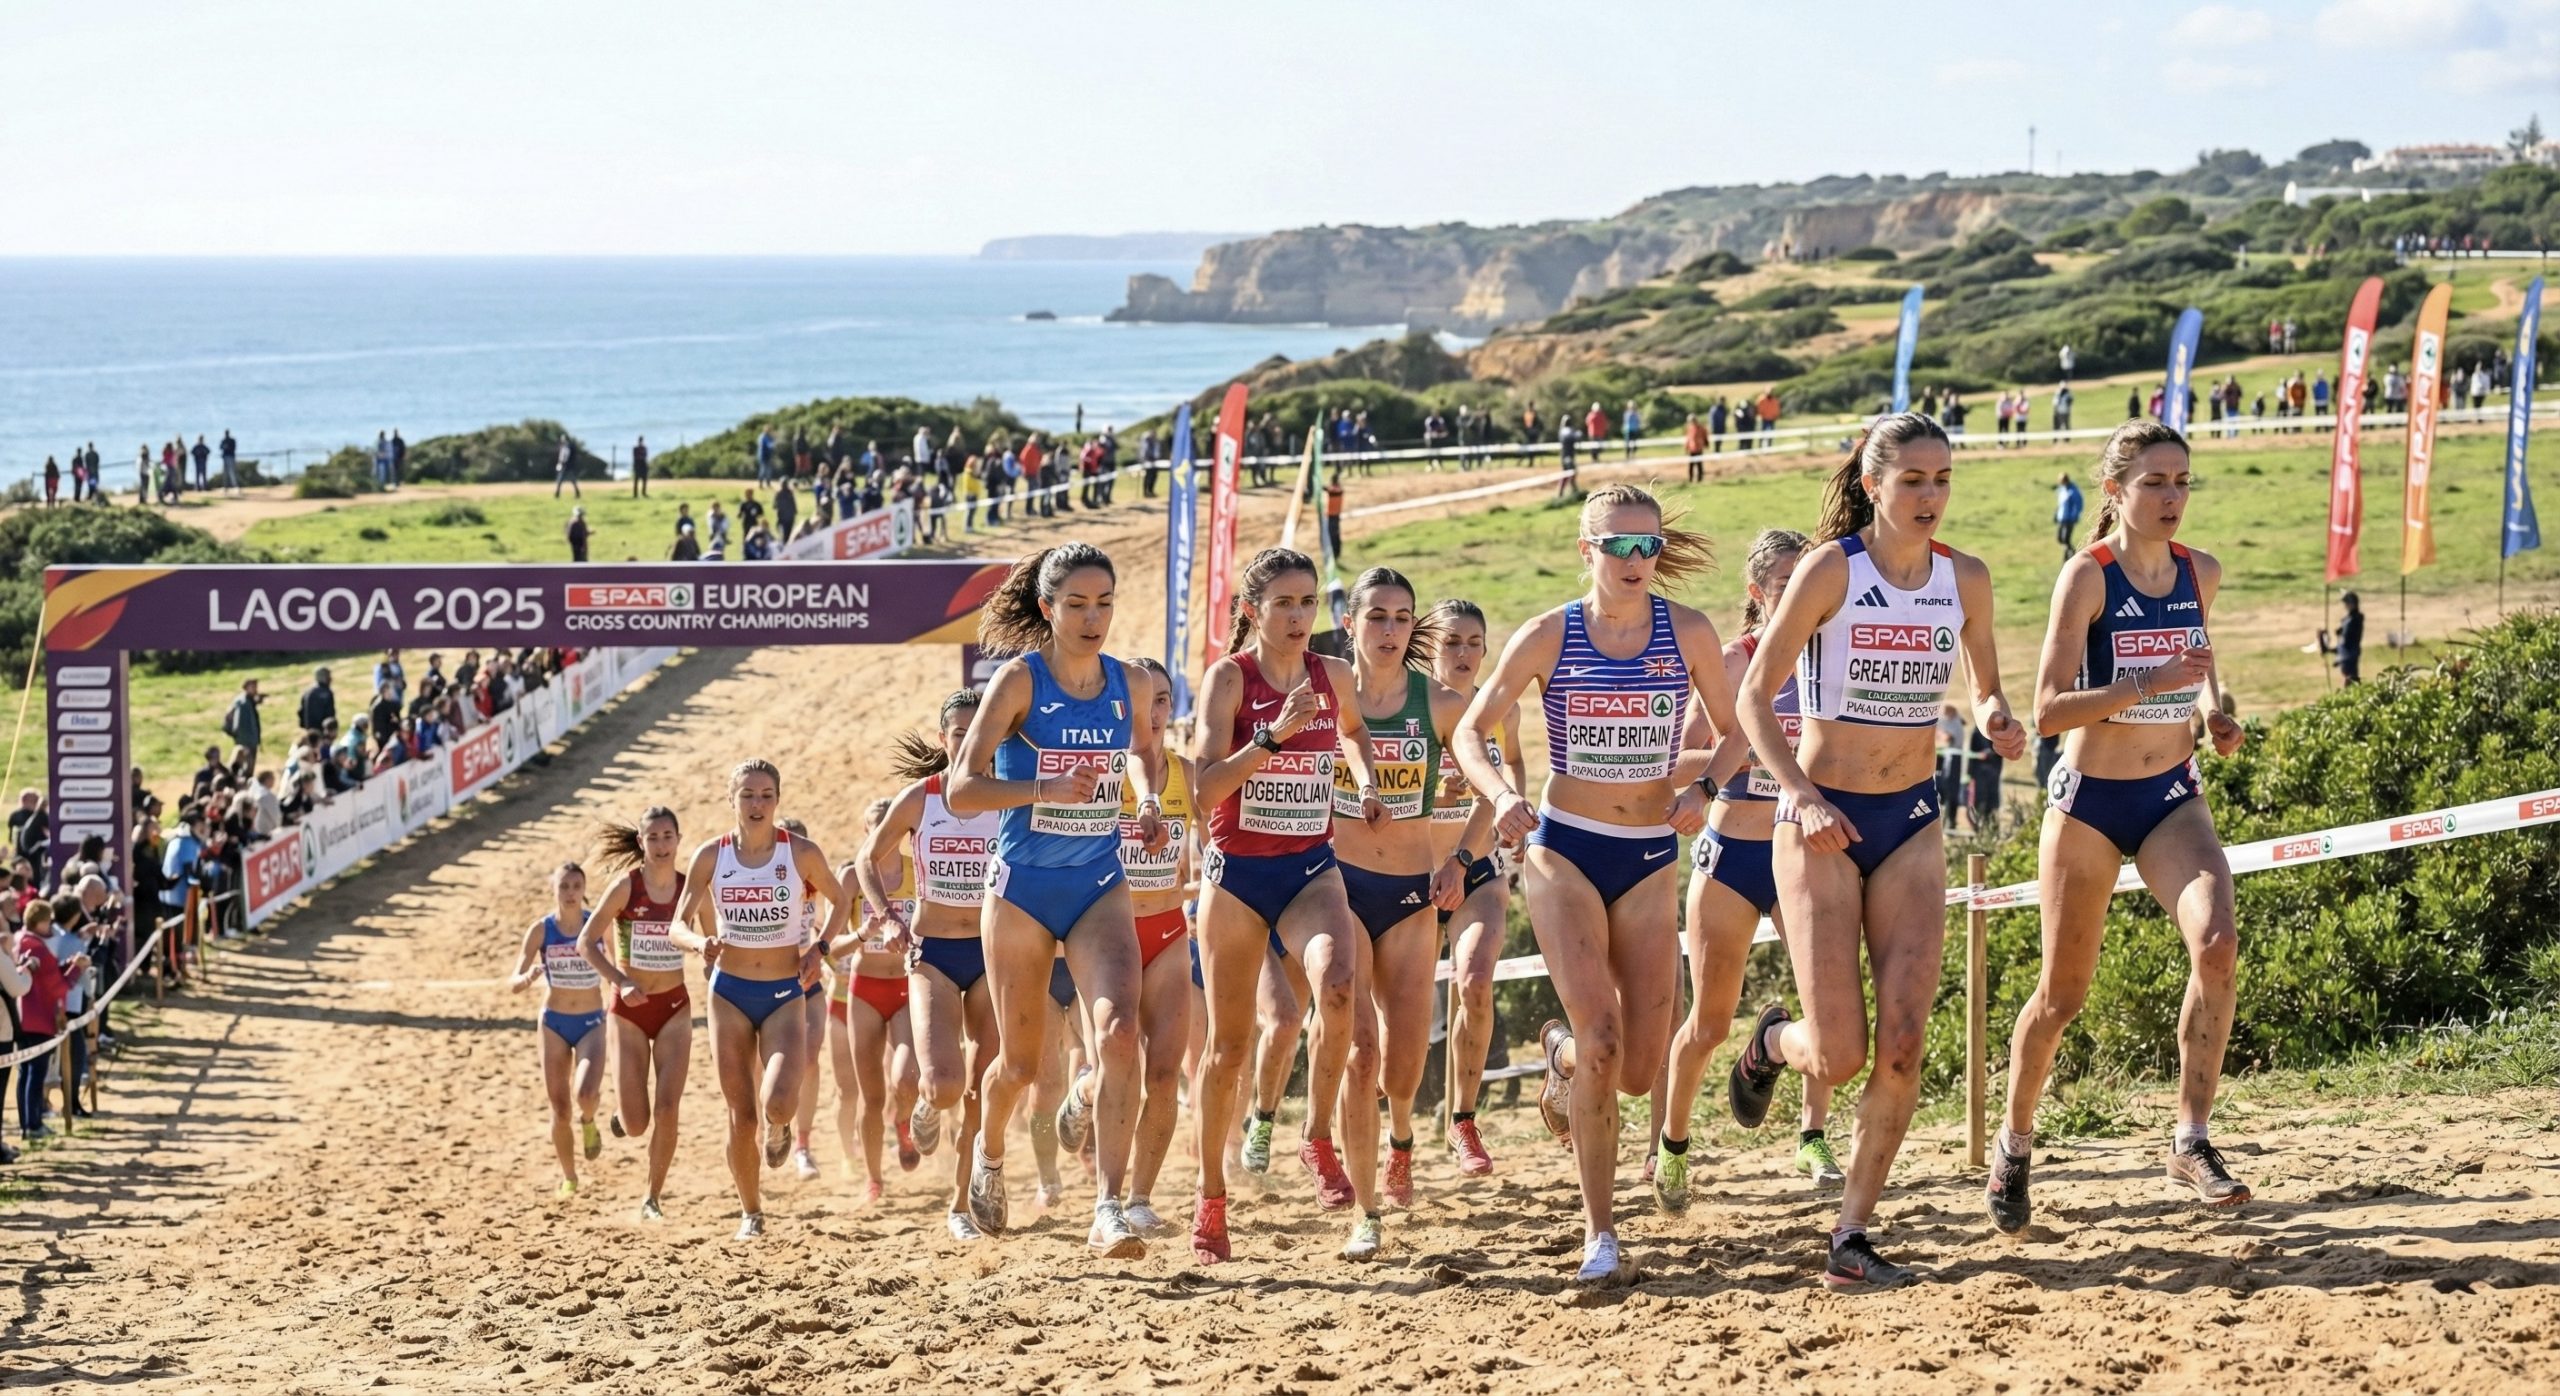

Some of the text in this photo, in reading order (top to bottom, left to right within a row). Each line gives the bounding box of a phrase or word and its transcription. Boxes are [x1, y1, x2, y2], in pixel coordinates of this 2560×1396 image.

[845, 519, 890, 557] SPAR
[589, 583, 869, 609] SPAR EUROPEAN
[208, 587, 545, 631] LAGOA 2025
[565, 612, 869, 630] CROSS COUNTRY CHAMPIONSHIPS
[1854, 626, 1930, 648] SPAR
[2117, 633, 2188, 654] SPAR
[1849, 658, 1953, 685] GREAT BRITAIN
[1571, 696, 1647, 714] SPAR
[1061, 728, 1114, 744] ITALY
[1569, 724, 1671, 748] GREAT BRITAIN
[463, 733, 501, 782] SPAR
[1334, 766, 1421, 789] PAANCA
[2051, 766, 2071, 801] 8
[2531, 797, 2560, 815] SPA
[2401, 820, 2442, 837] SPAR
[930, 838, 984, 853] SPAR
[2283, 842, 2320, 858] SPAR
[259, 841, 300, 896] SPAR
[722, 888, 772, 901] SPAR
